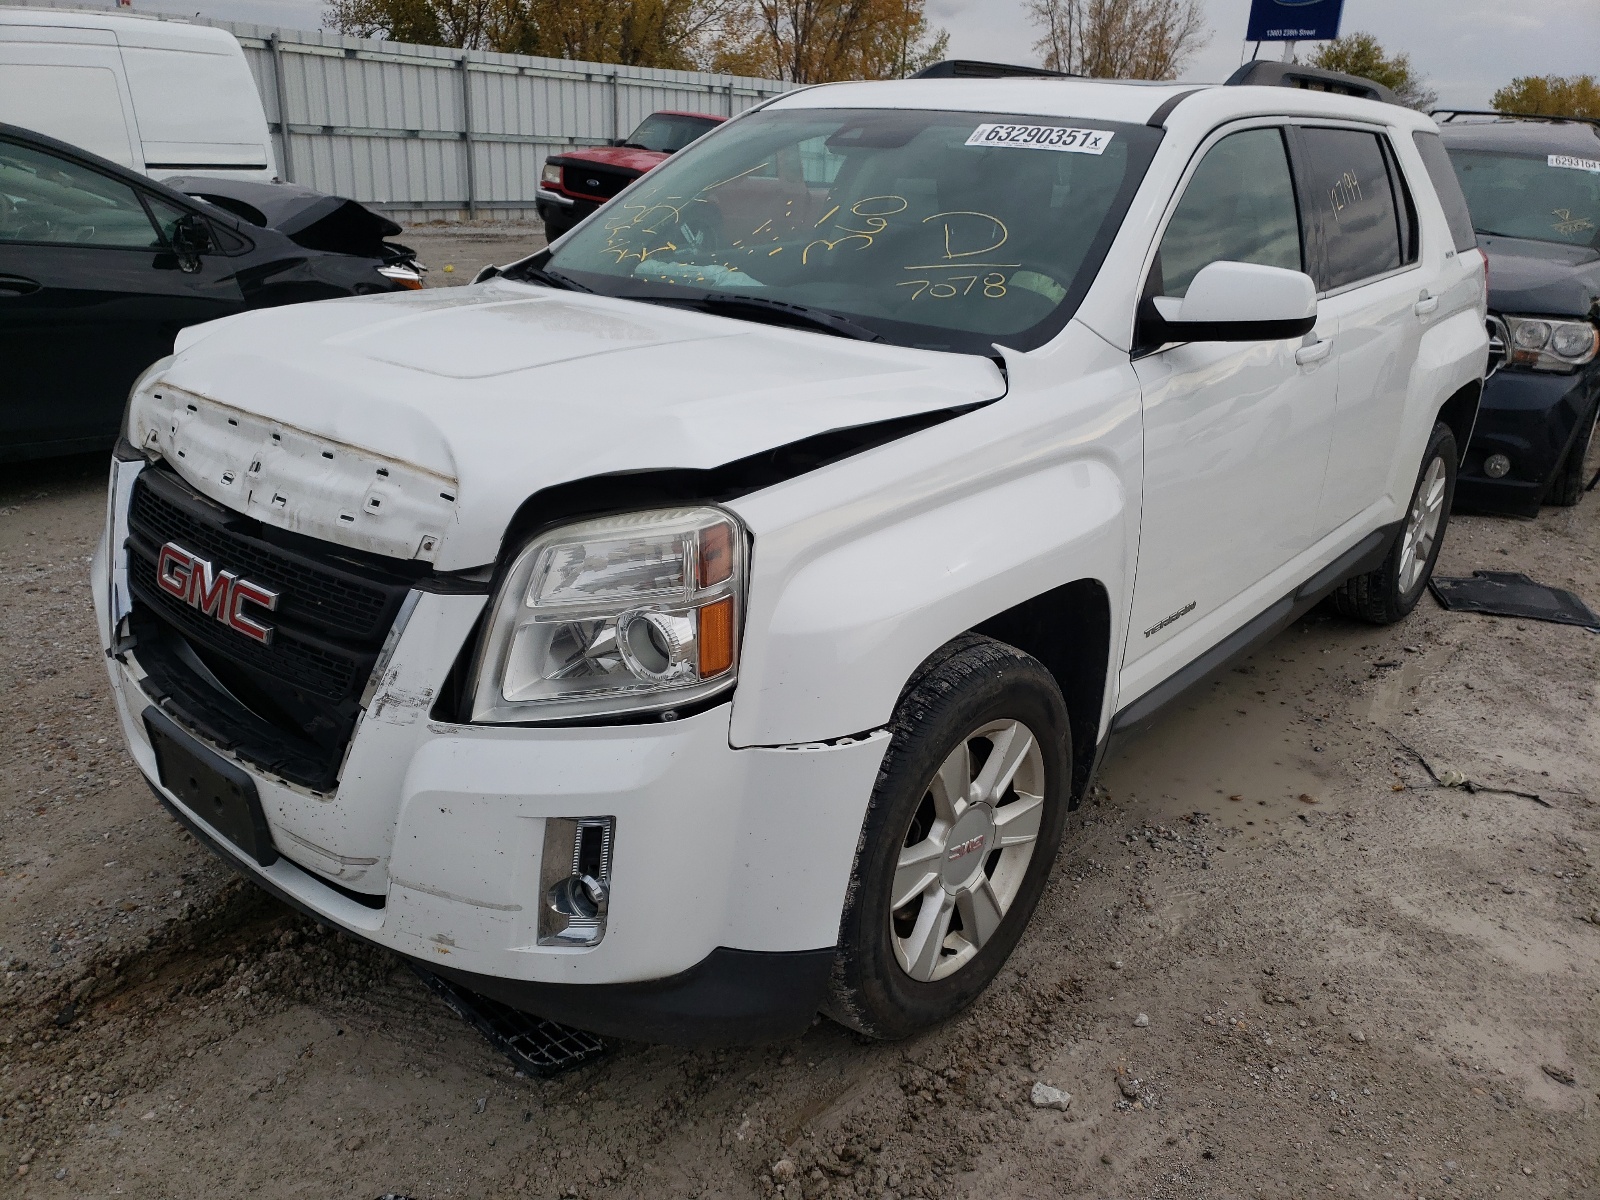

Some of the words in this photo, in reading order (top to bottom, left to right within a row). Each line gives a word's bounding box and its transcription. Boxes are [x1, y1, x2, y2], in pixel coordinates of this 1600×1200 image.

[985, 126, 1093, 147] 63290351
[1555, 156, 1600, 169] 6293164
[923, 211, 1008, 260] D
[896, 273, 1007, 301] 7078
[157, 542, 279, 646] GMC
